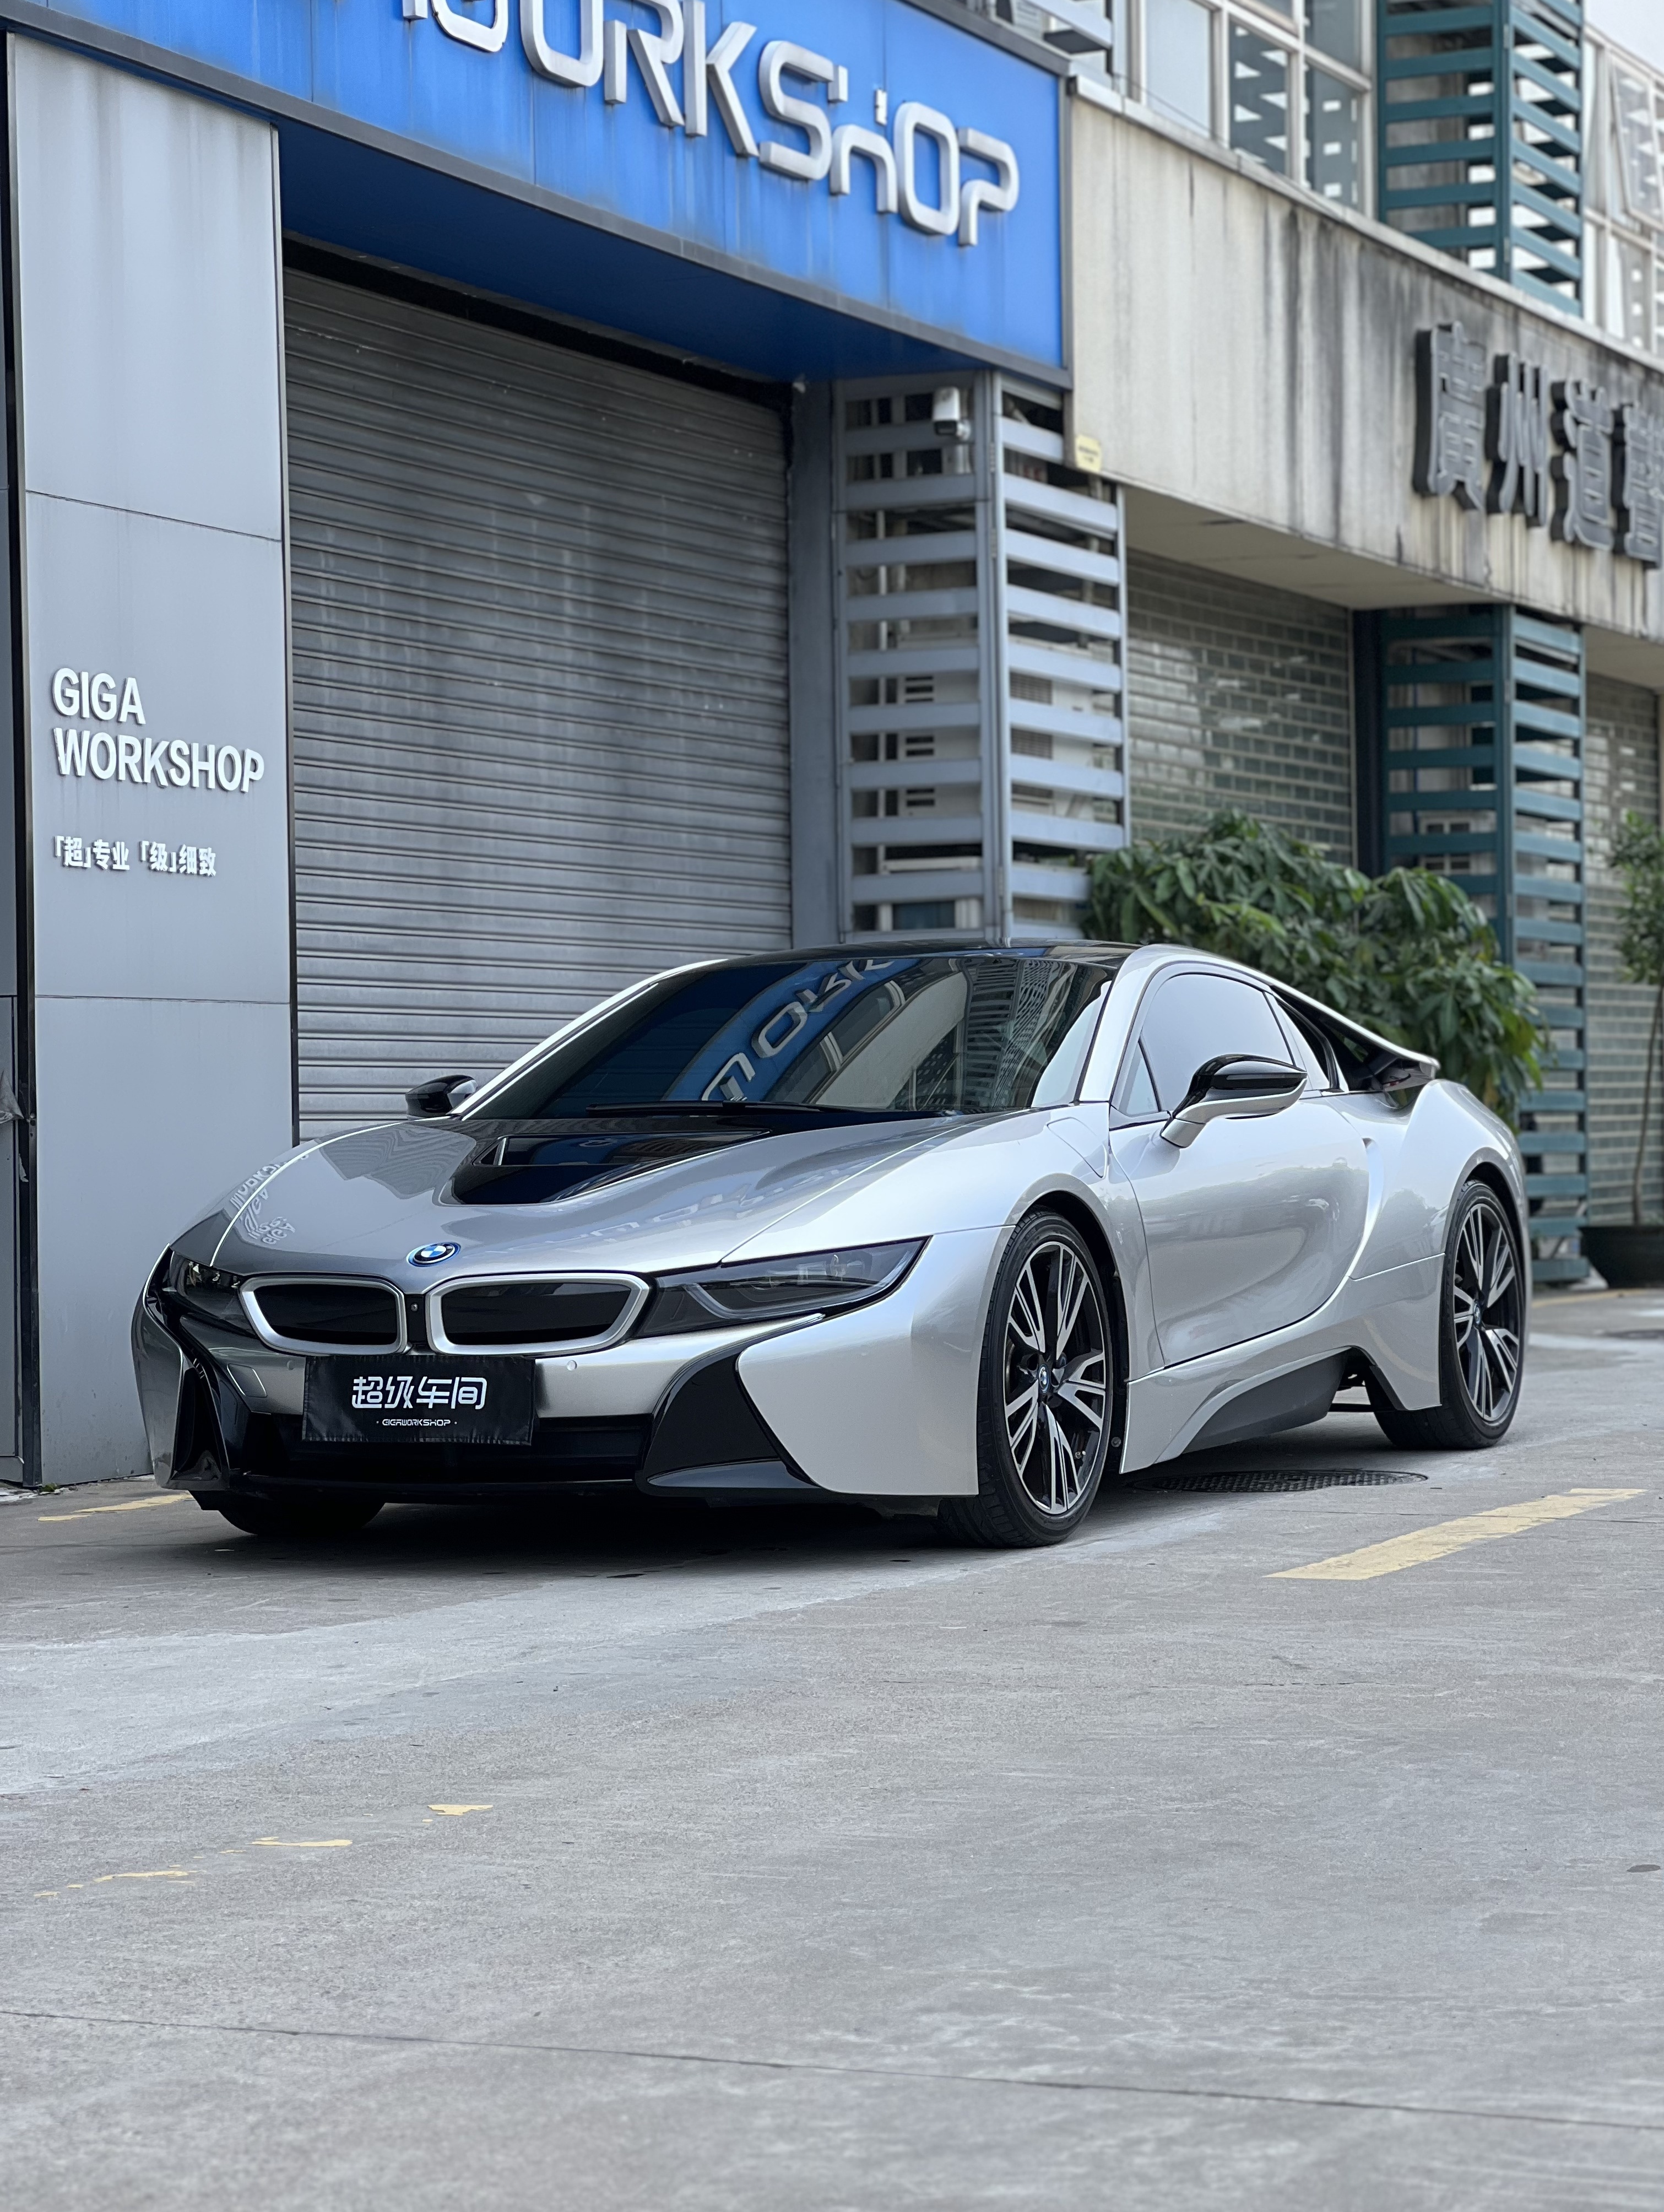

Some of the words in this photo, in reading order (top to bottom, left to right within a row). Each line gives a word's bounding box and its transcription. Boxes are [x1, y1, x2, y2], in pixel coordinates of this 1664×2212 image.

[403, 0, 1019, 246] ORKSHOP
[52, 667, 146, 725] GIGA
[53, 727, 265, 793] WORKSHOP
[351, 1376, 487, 1410] 超级车间
